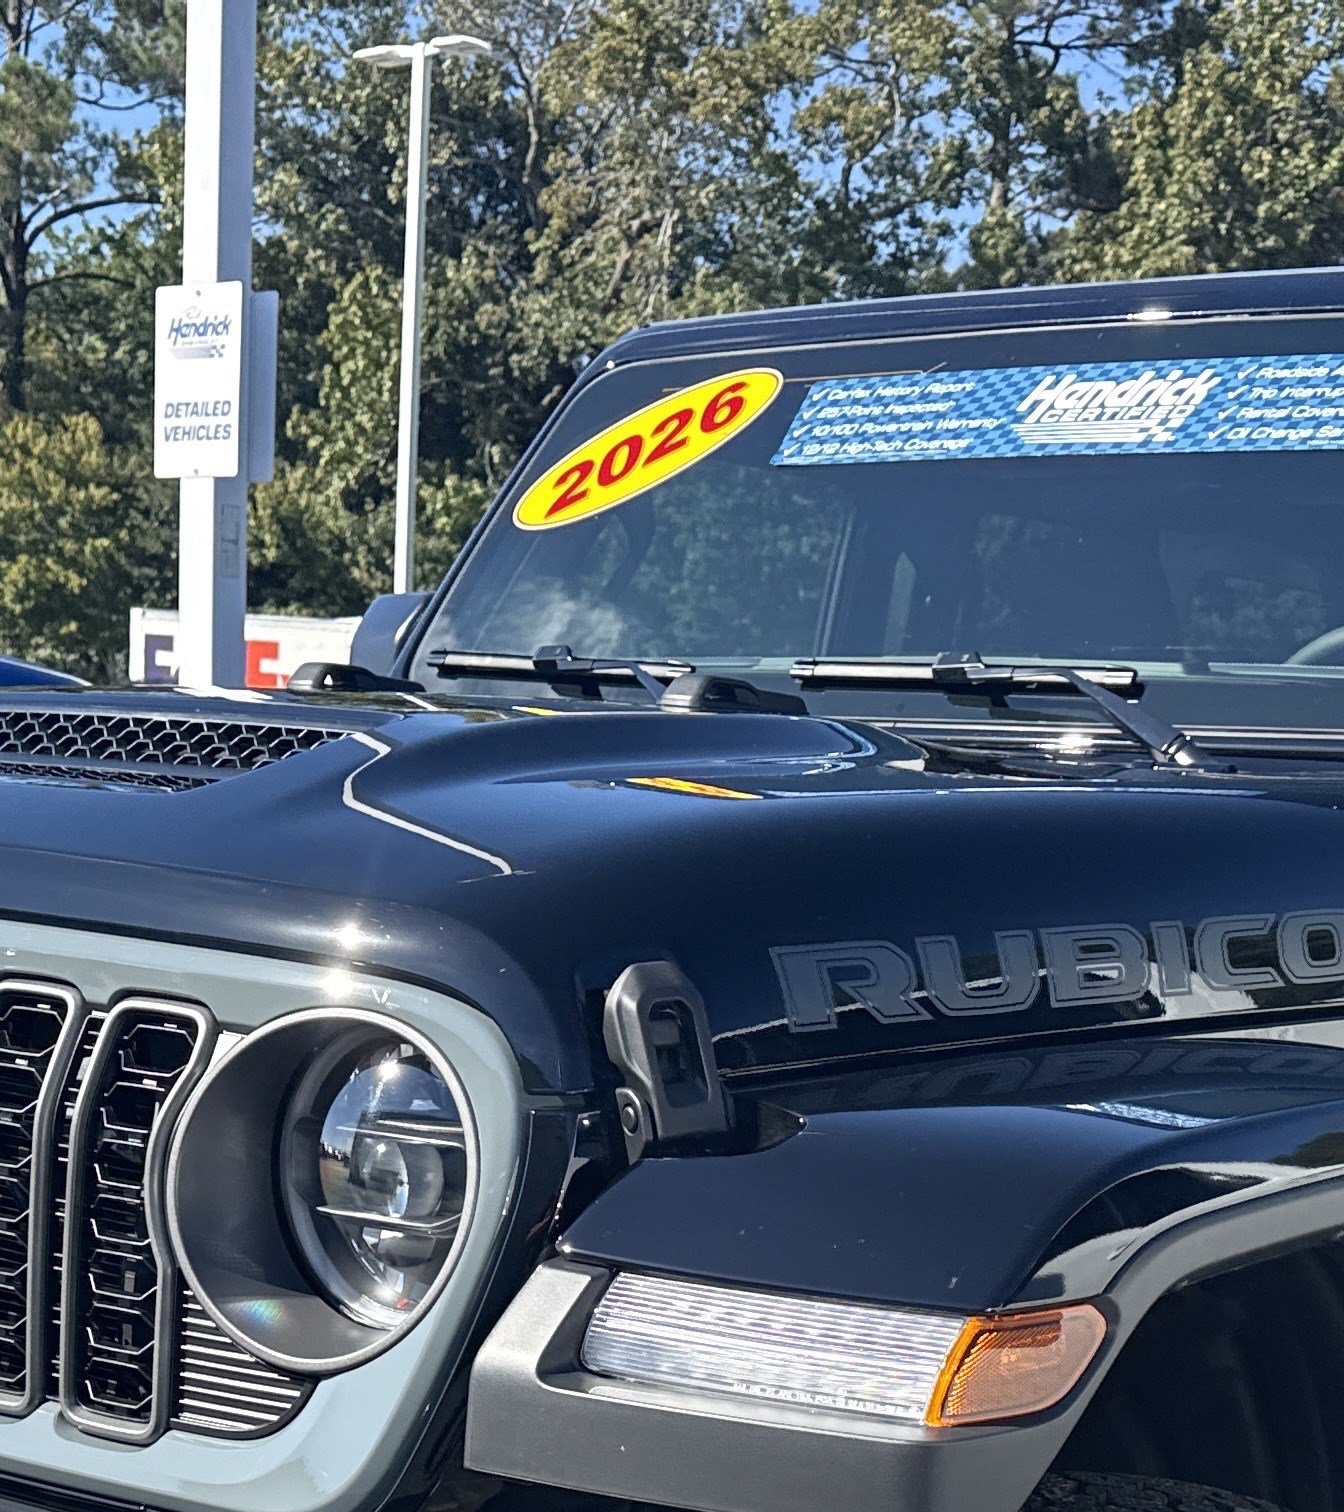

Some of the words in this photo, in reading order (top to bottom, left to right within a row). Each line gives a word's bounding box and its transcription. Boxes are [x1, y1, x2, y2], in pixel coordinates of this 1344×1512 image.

[167, 315, 232, 346] Hendrick
[1256, 365, 1329, 379] Roadside
[875, 385, 923, 398] History
[923, 382, 976, 395] Report
[1016, 369, 1222, 424] Hendrick
[1249, 386, 1279, 400] Trip
[164, 400, 231, 420] DETAILED
[1040, 405, 1196, 422] CERTIFIED
[1236, 405, 1290, 420] Rental
[164, 424, 231, 443] VEHICLES
[1227, 427, 1253, 440] Oil
[1251, 427, 1314, 441] Change
[544, 381, 750, 520] 2026
